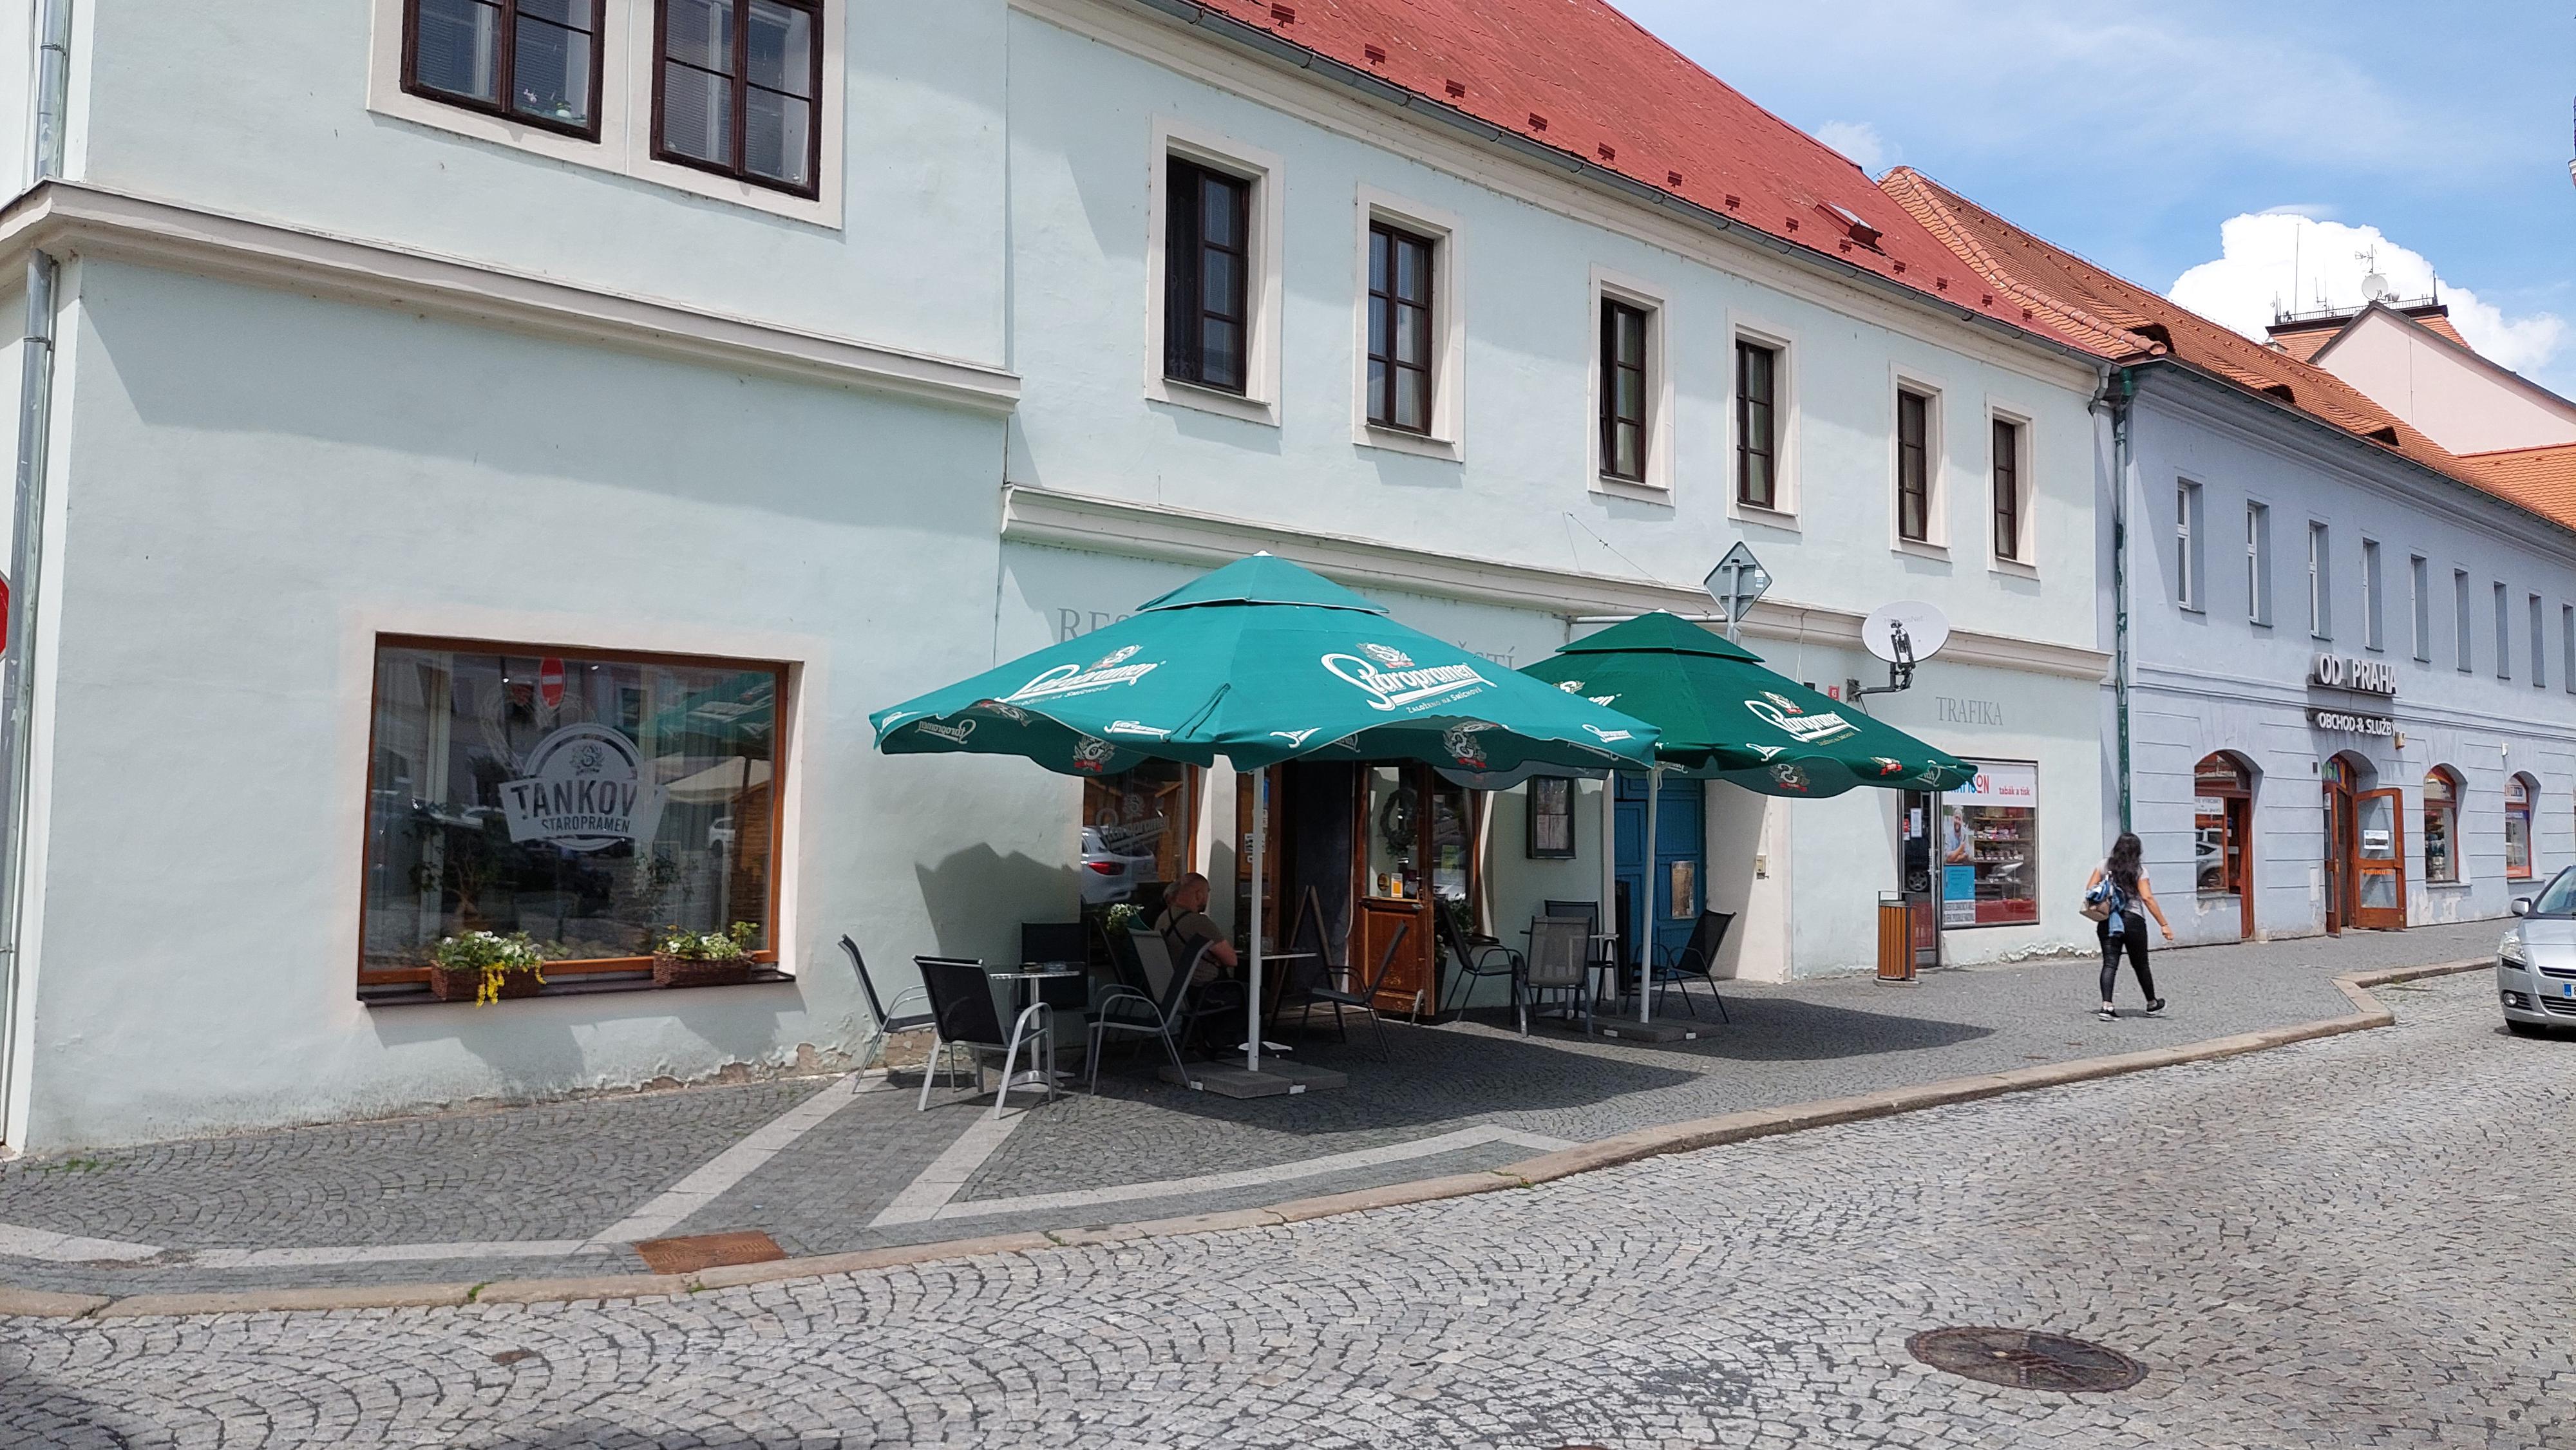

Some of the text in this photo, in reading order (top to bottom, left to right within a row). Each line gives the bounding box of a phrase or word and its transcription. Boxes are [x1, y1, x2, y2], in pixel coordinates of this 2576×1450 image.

[1321, 652, 1498, 711] Staropramen
[2320, 654, 2398, 695] OD PRAHA
[1936, 697, 2003, 726] TRAFIKA
[2319, 711, 2396, 737] OBCHOD & SLUŽBY
[511, 780, 659, 820] TANKOV
[542, 815, 630, 833] STAROPRAMEN
